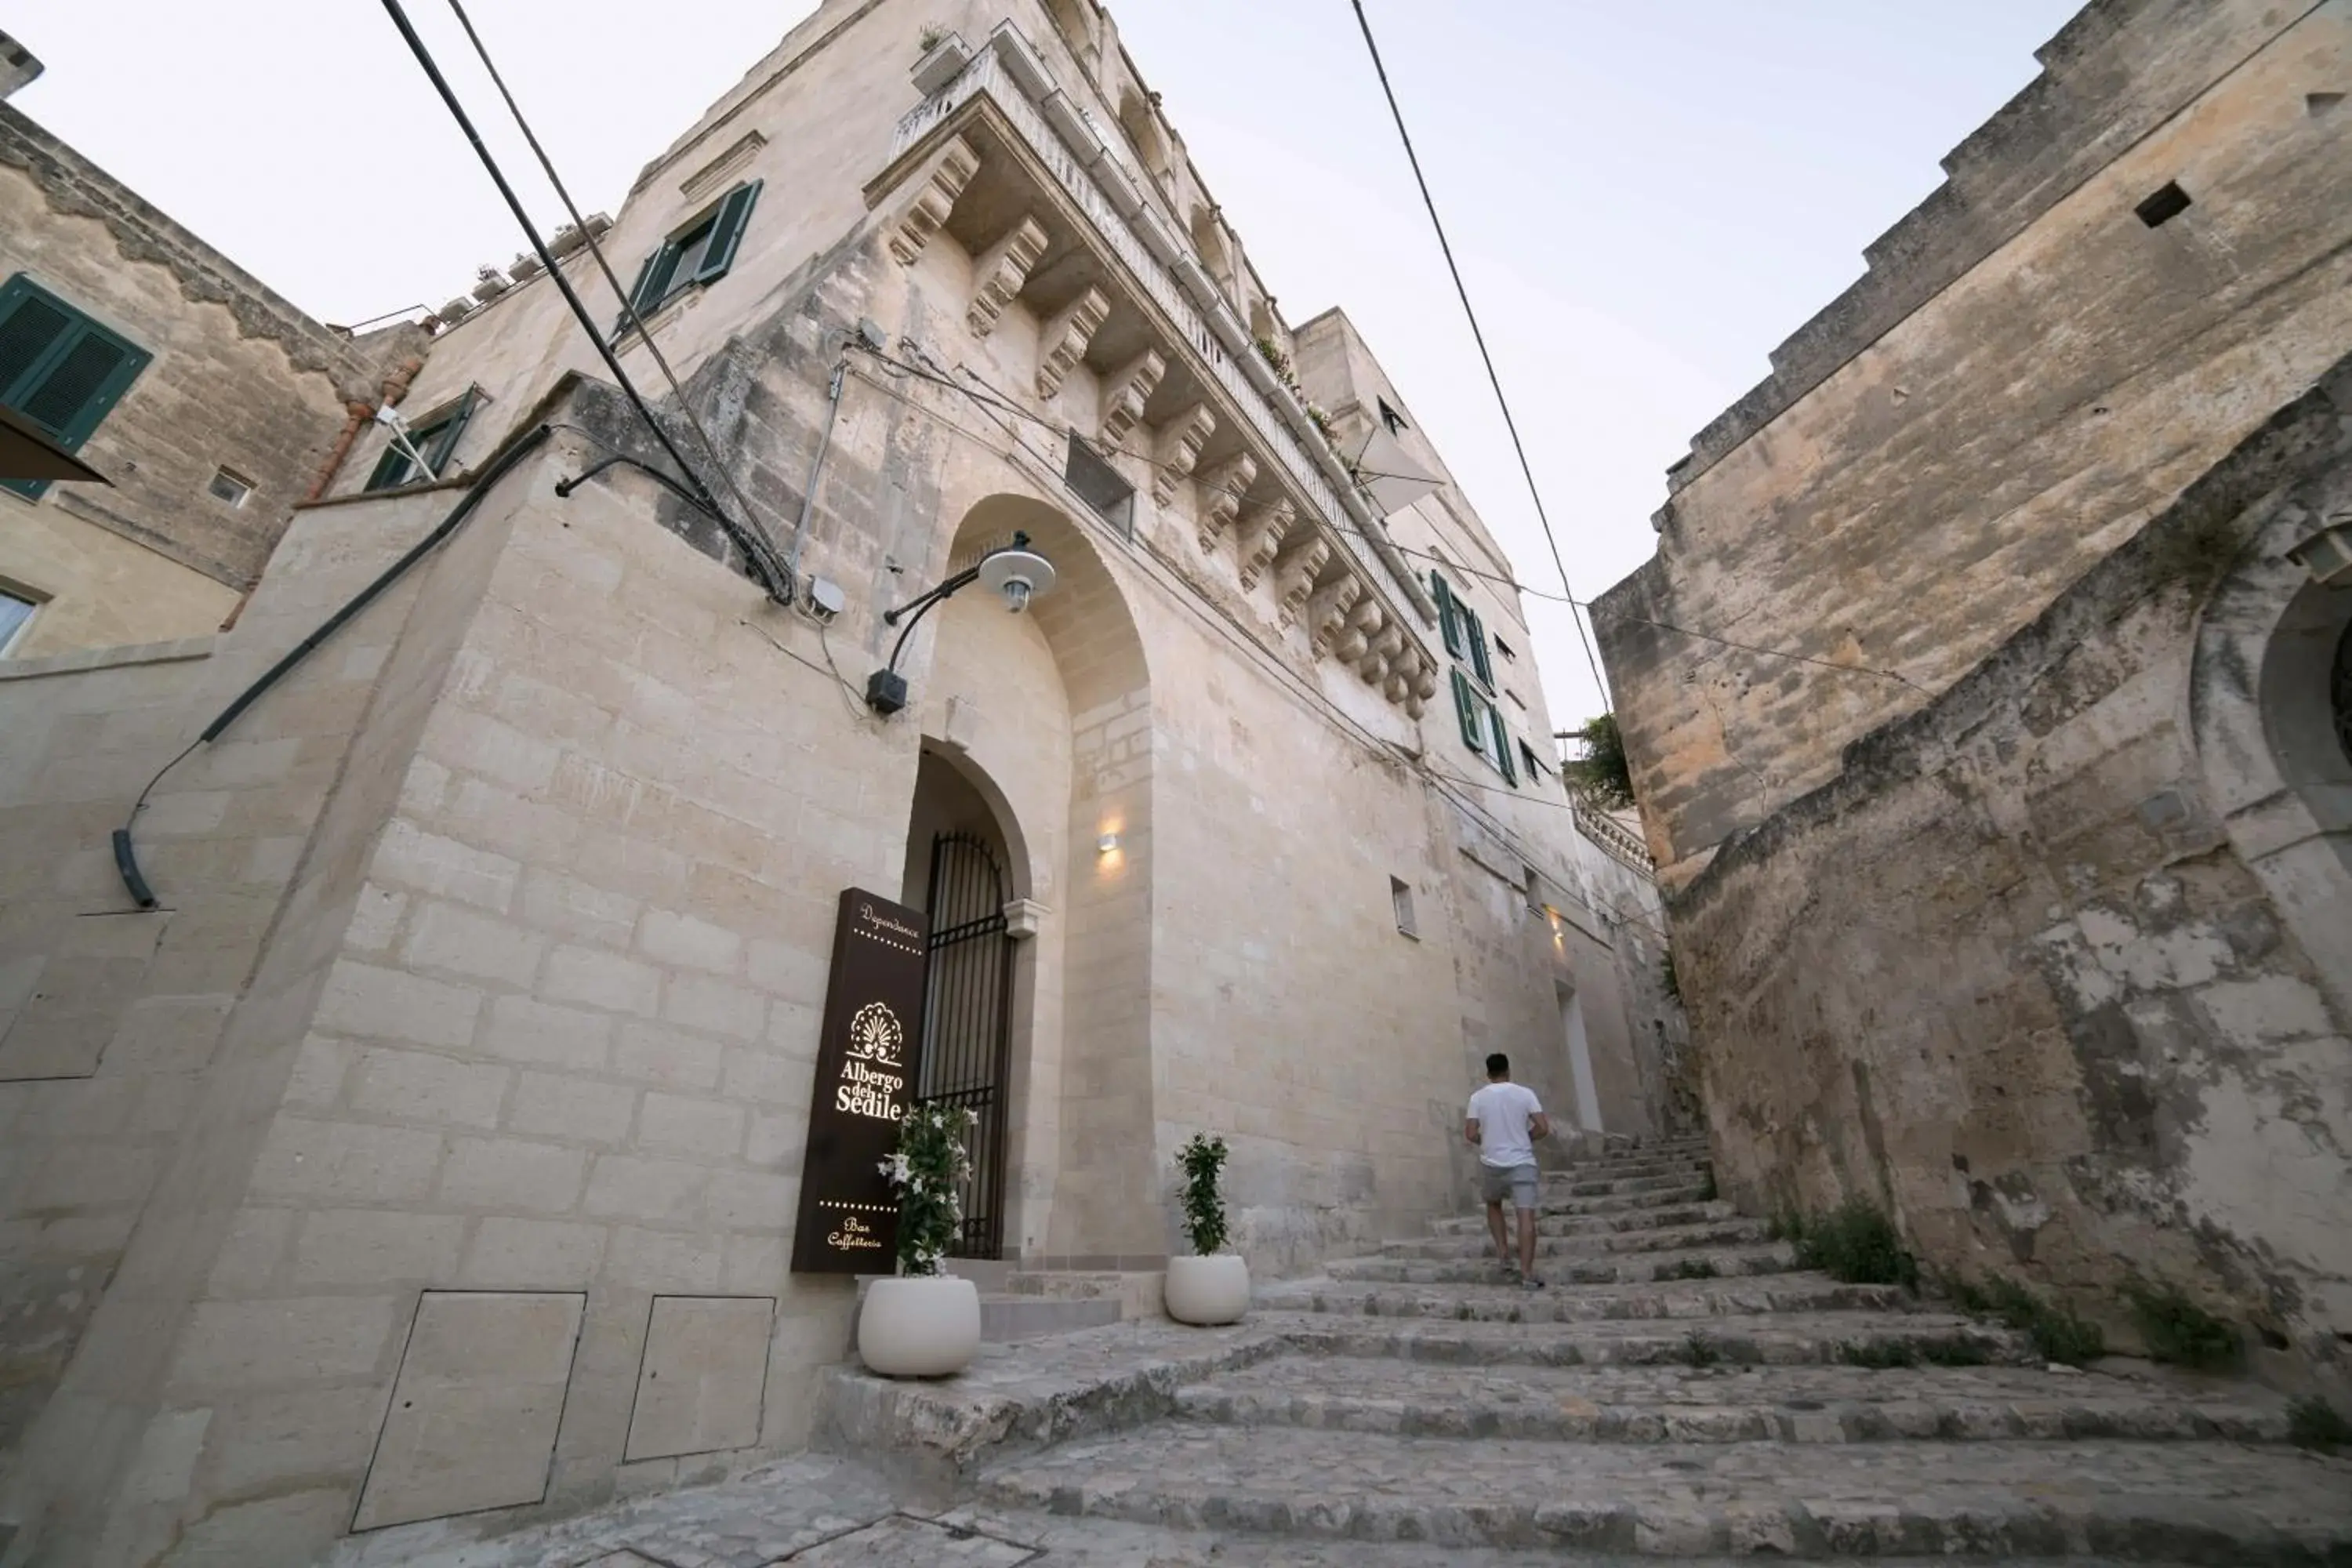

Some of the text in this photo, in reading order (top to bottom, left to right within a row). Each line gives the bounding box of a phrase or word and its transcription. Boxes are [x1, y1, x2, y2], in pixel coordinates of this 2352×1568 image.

[840, 1059, 903, 1094] Albergo
[851, 1081, 872, 1098] del
[836, 1085, 901, 1120] Sedile
[844, 1216, 870, 1233] Bar
